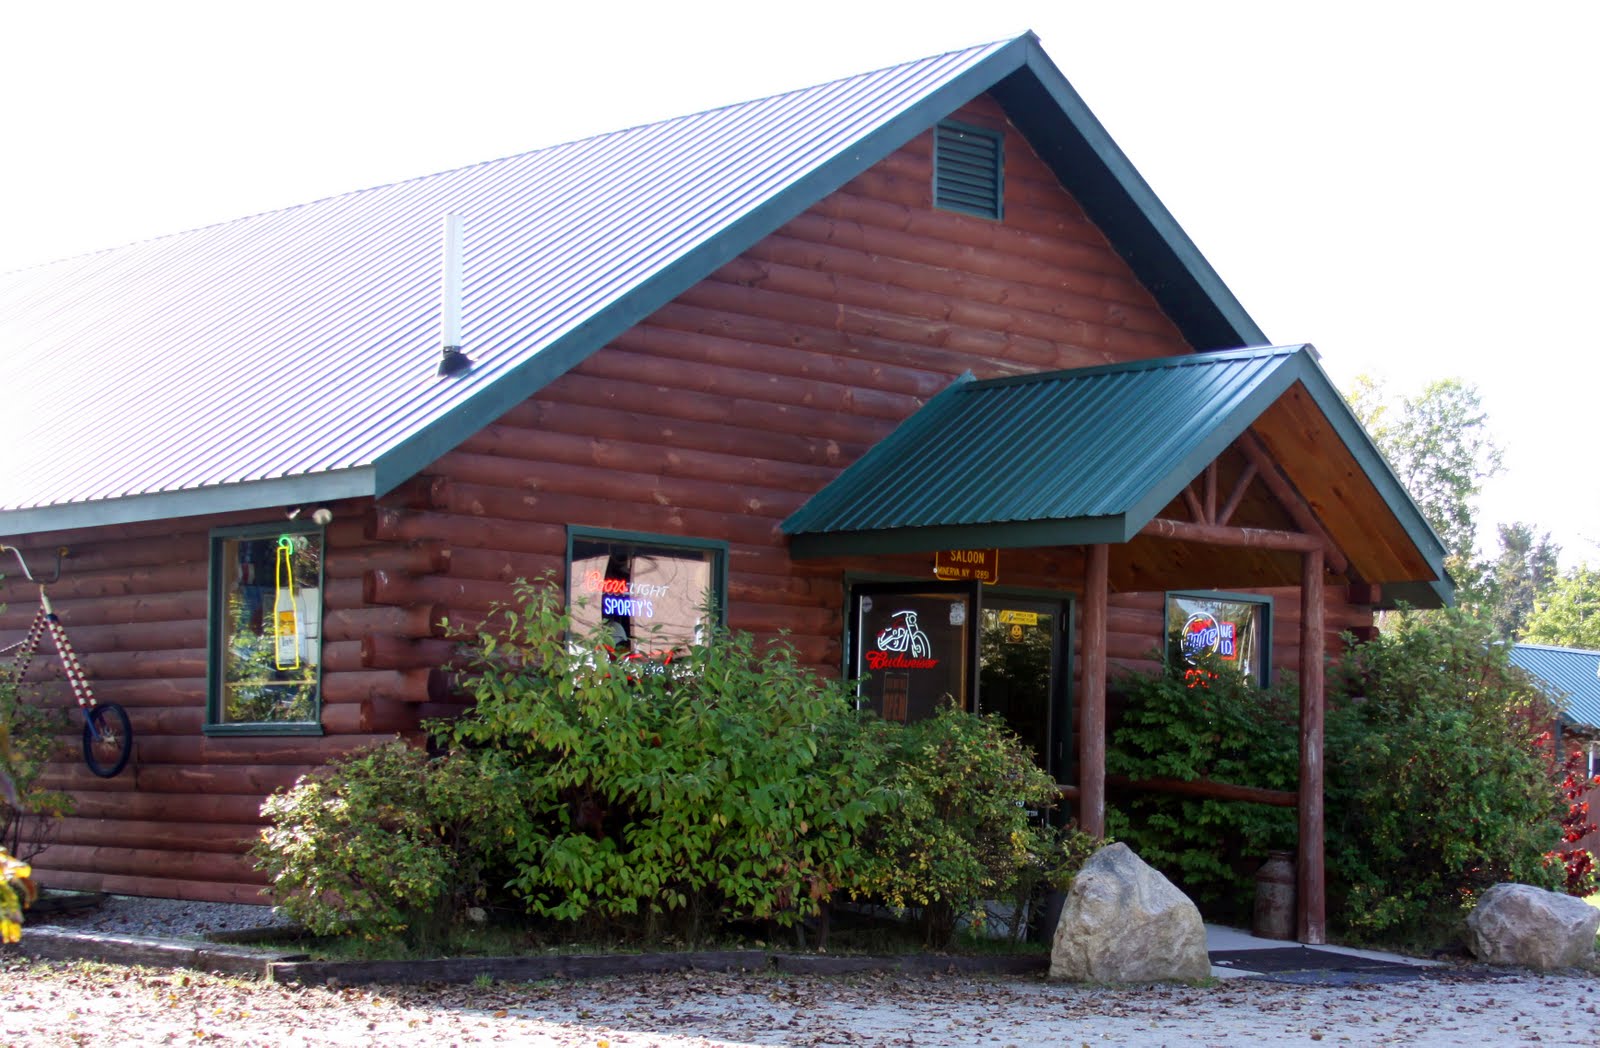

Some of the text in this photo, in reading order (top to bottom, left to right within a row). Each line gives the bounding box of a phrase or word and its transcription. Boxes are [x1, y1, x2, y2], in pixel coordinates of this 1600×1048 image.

[951, 550, 985, 564] SALOON
[938, 566, 960, 577] MINERVA
[961, 568, 970, 577] NY
[584, 570, 669, 597] Coors LIGHT
[604, 597, 653, 618] SPORTY'S
[1220, 624, 1233, 638] WE
[865, 650, 938, 669] Budweiser
